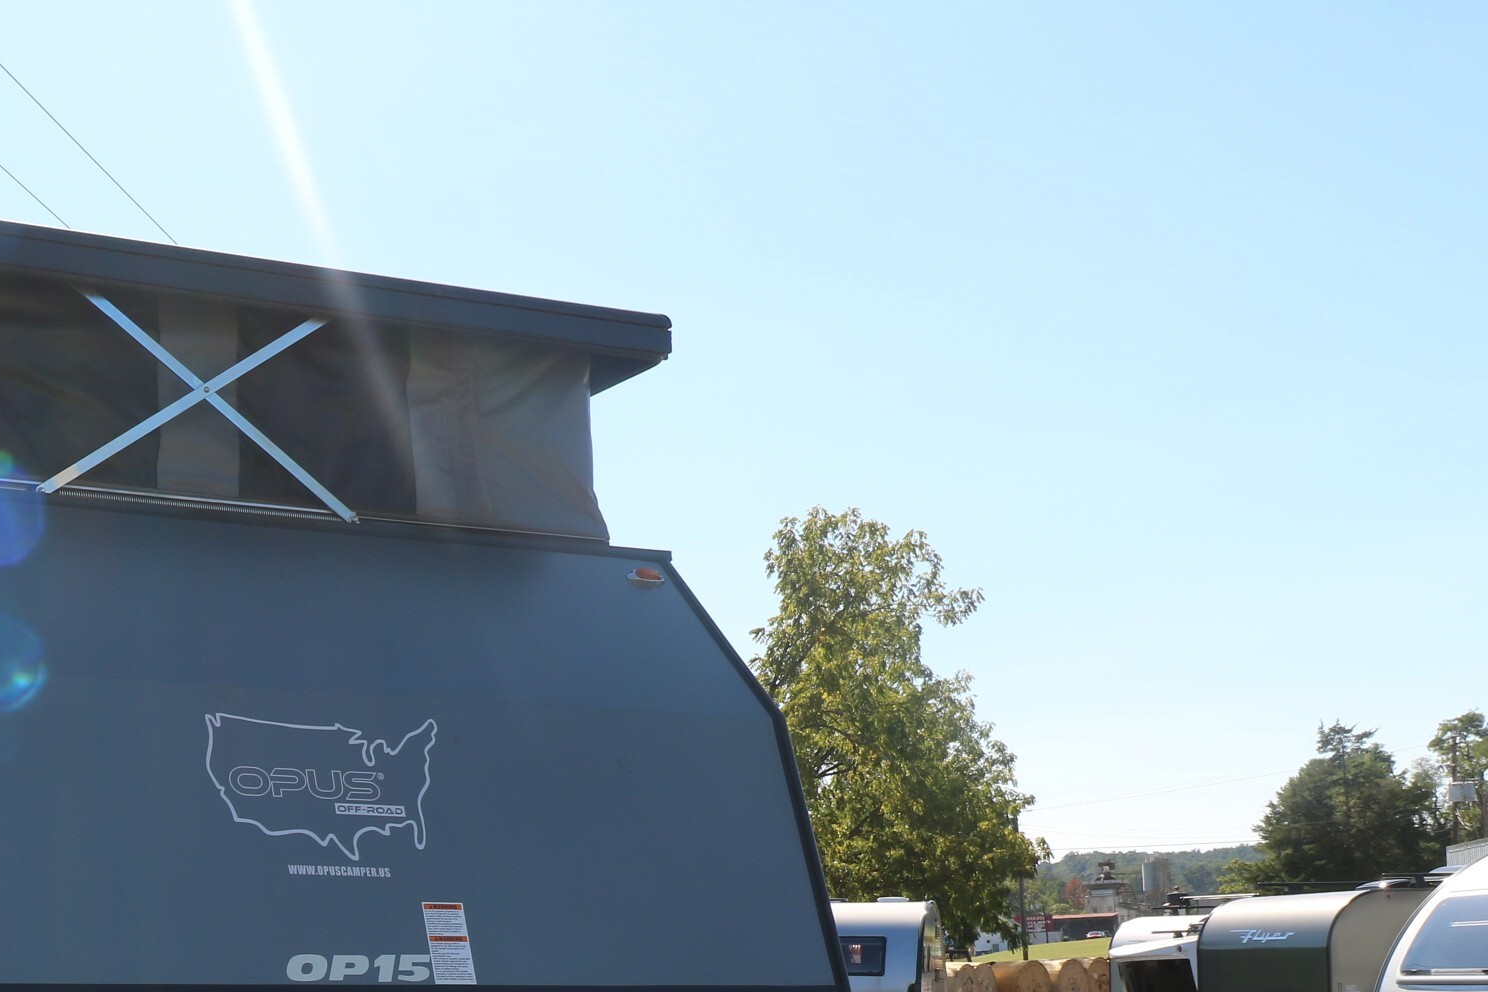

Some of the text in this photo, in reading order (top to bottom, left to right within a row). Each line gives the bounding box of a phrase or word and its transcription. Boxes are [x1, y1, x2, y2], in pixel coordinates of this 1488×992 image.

[228, 765, 381, 801] OPUS
[337, 804, 404, 816] OFF-ROAD
[288, 864, 391, 878] WWW.OPUSCAMPER.US
[1229, 929, 1294, 944] Flyer
[286, 954, 431, 983] OP15
